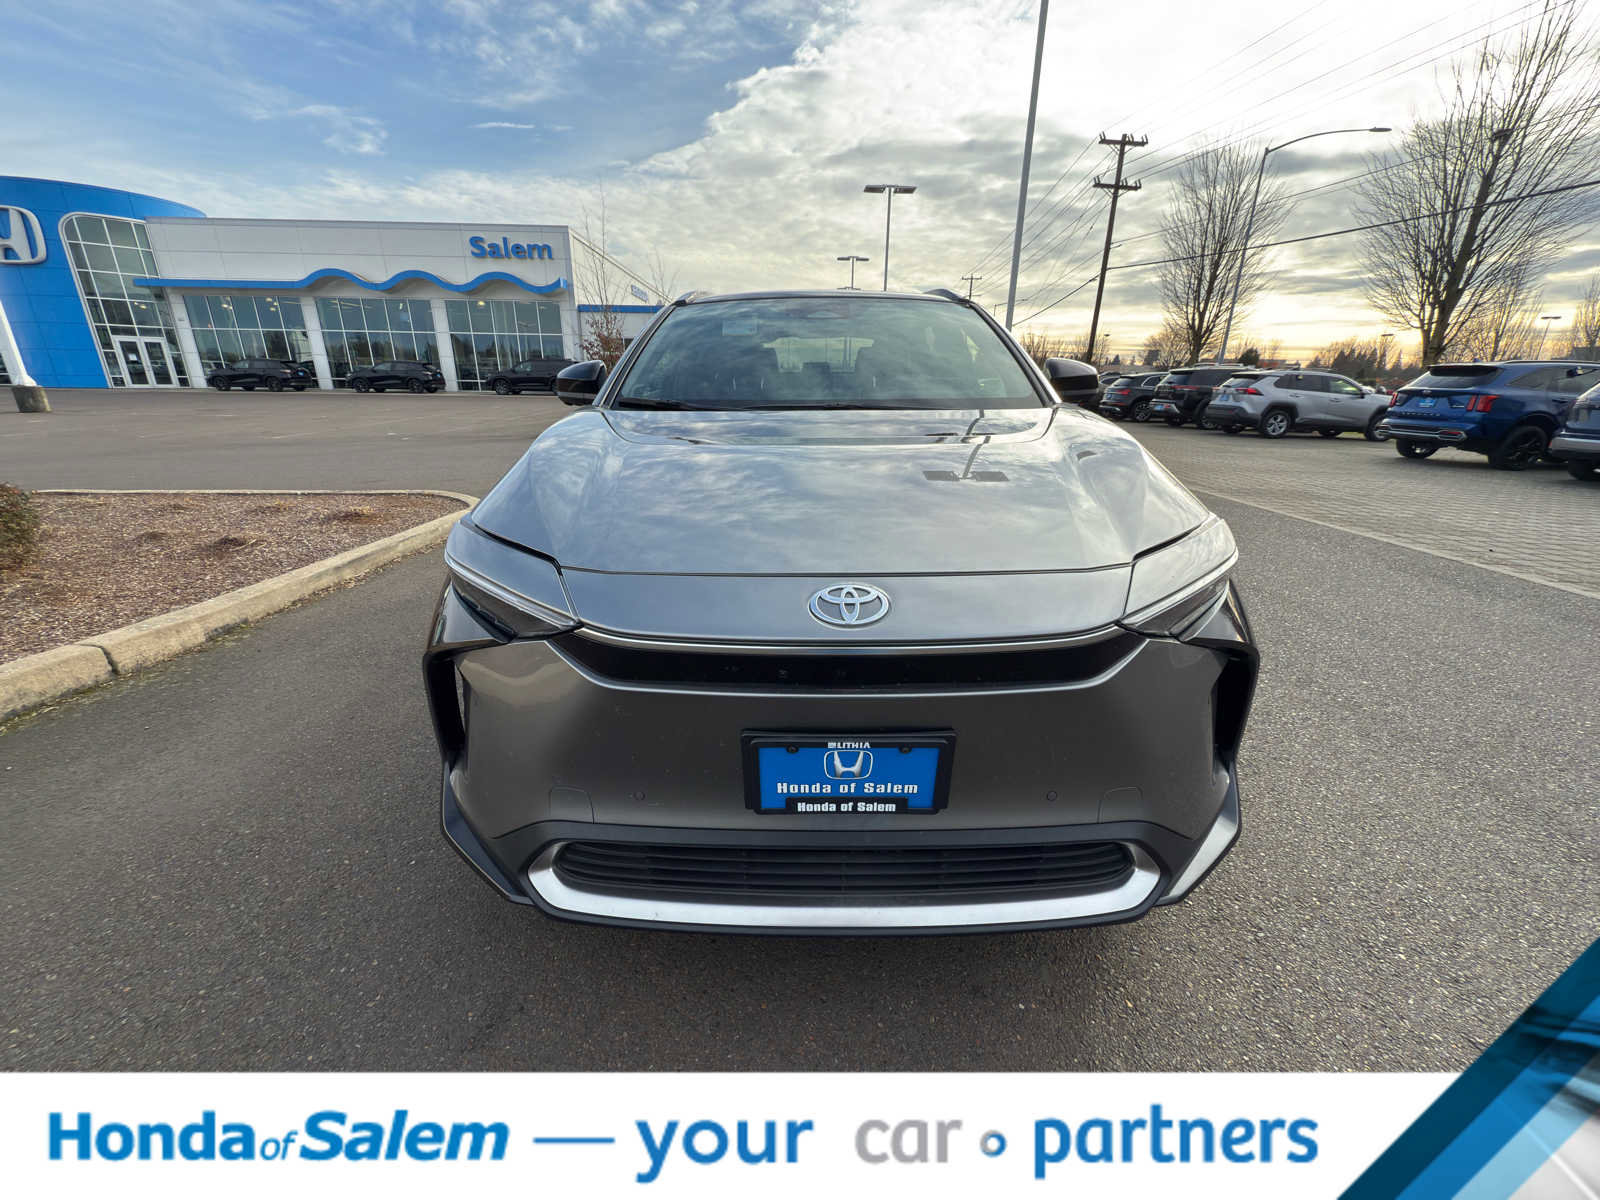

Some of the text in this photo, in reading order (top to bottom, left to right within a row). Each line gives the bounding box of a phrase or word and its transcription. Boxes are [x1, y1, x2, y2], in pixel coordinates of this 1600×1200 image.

[469, 235, 553, 260] Salem
[837, 741, 871, 749] LITHIA
[777, 782, 918, 794] Honda of Salem
[797, 802, 896, 812] Honda of Salem
